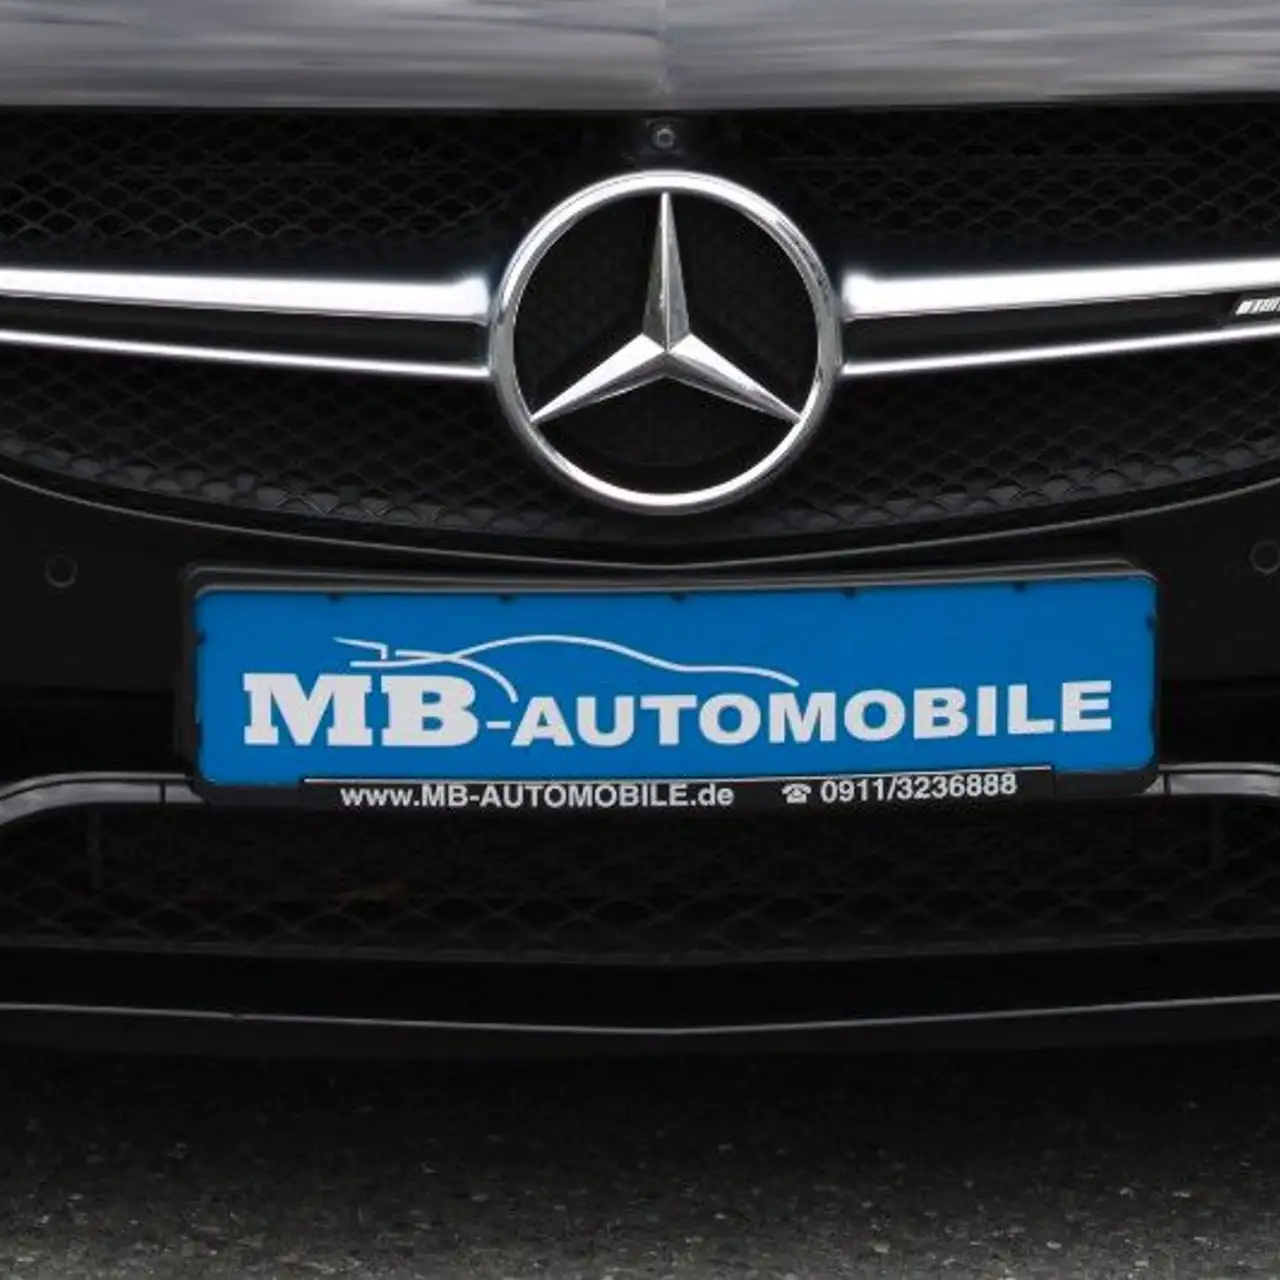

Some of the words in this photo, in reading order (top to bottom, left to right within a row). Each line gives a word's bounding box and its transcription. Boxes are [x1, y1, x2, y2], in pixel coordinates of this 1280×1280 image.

[243, 672, 1112, 748] MB-AUTOMOBILE
[340, 782, 735, 808] www.MB-AUTOMOBILE.de
[821, 772, 1018, 802] 0911/3236888
